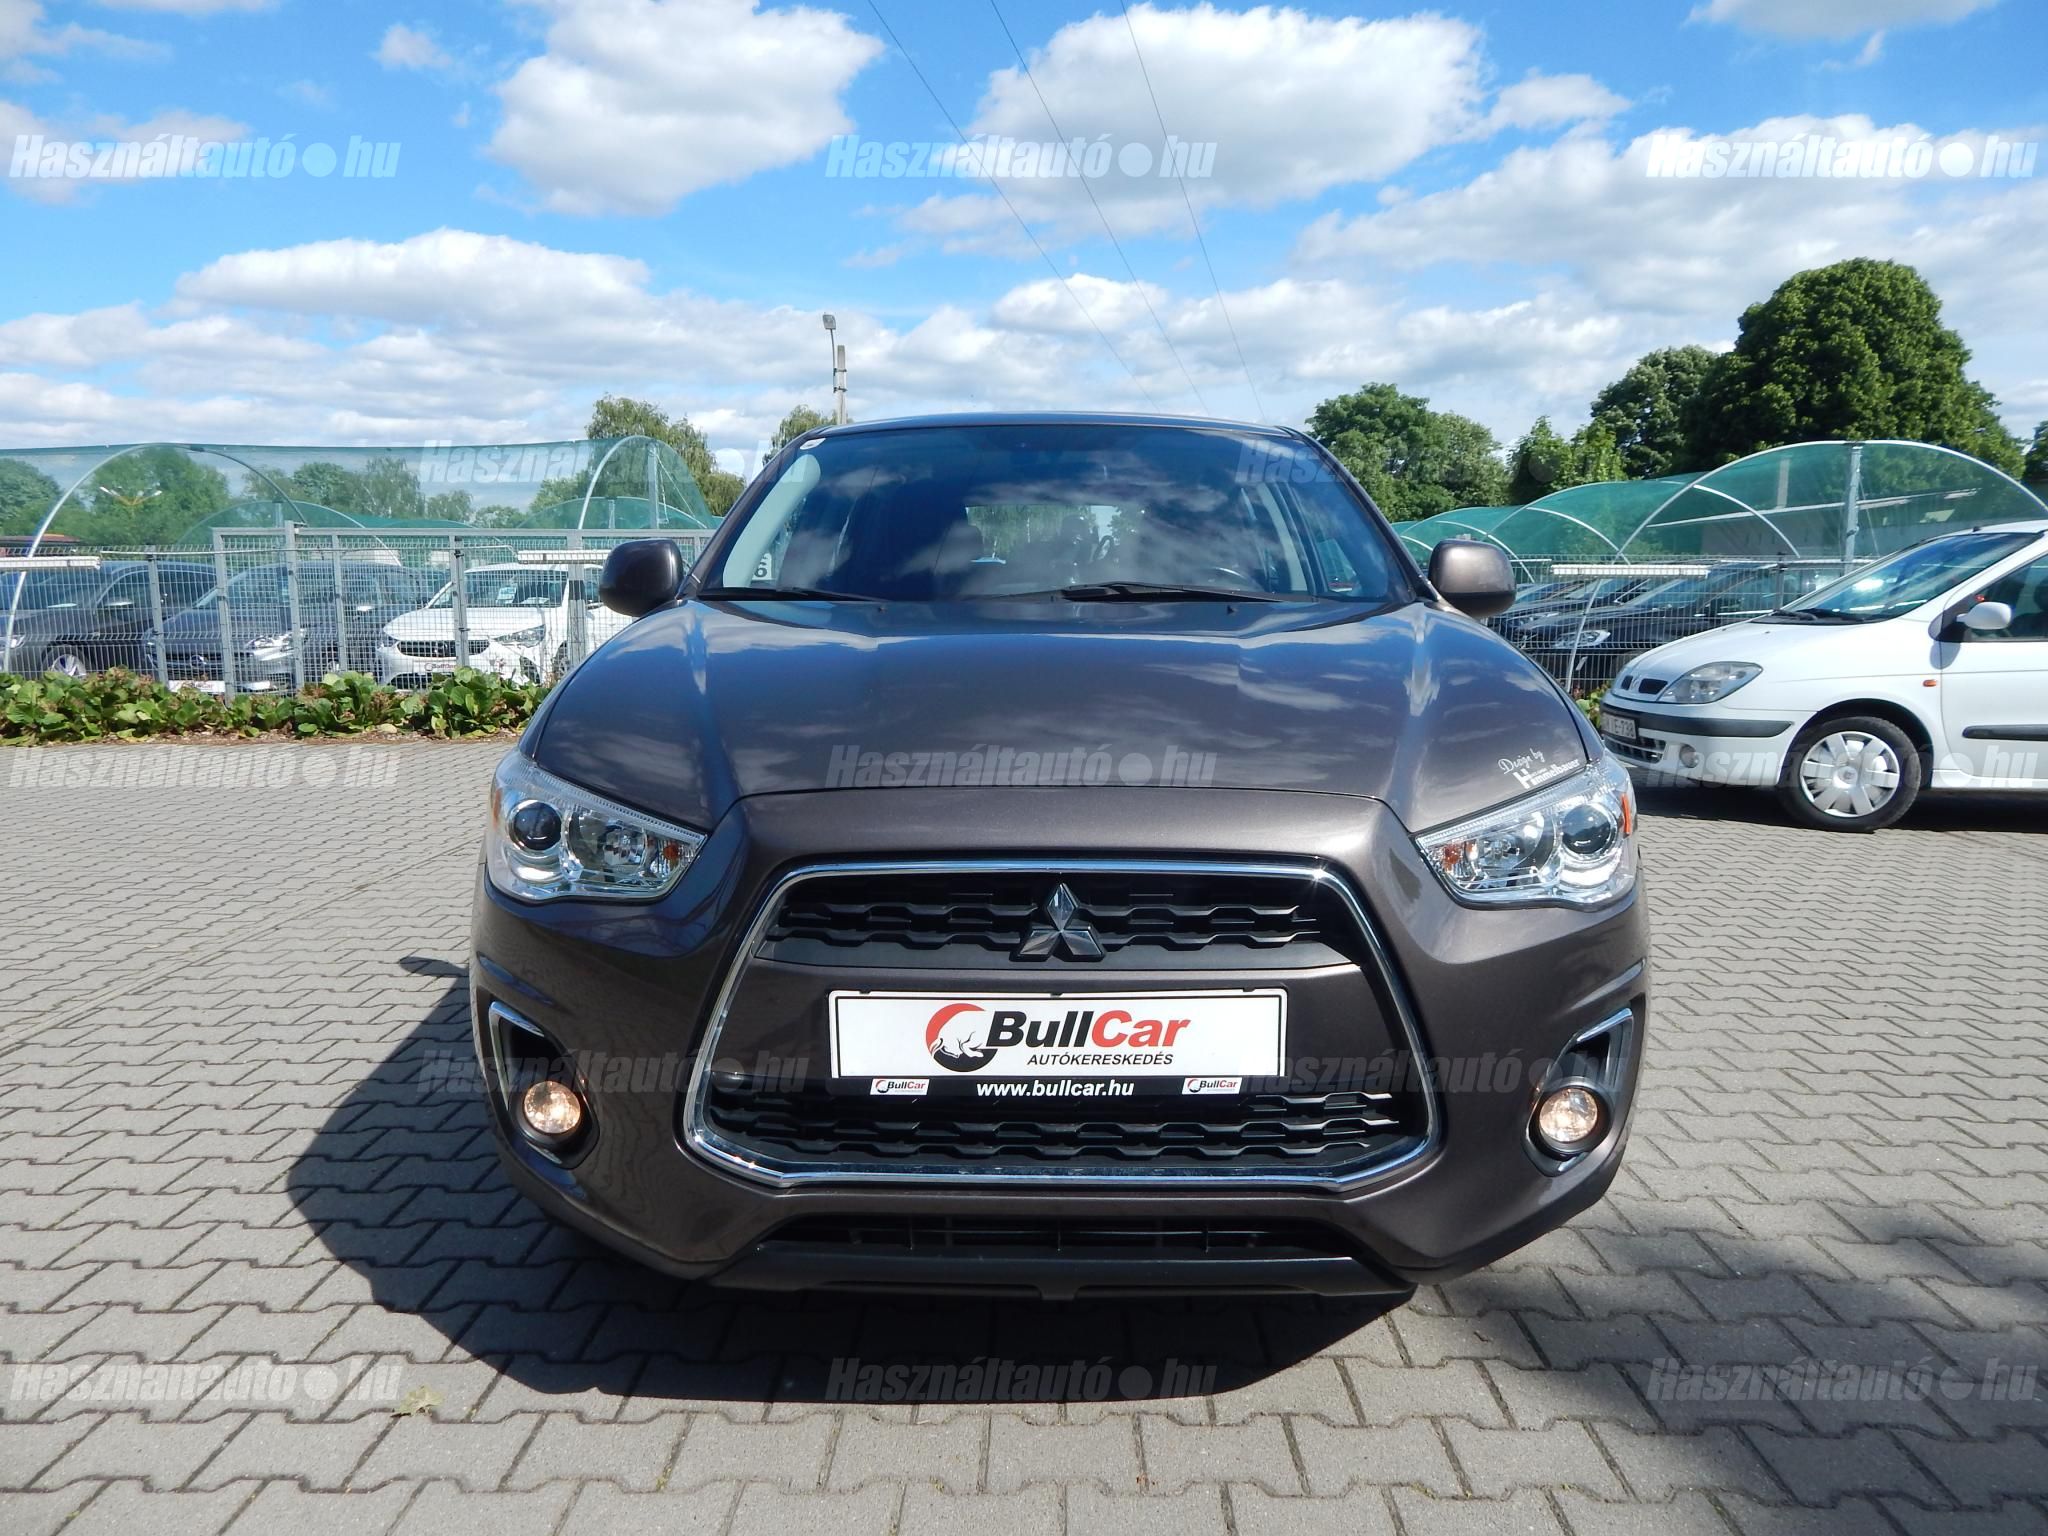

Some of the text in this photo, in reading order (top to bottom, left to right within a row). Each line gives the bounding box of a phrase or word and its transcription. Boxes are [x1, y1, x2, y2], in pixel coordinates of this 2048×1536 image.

[986, 1010, 1192, 1048] BullCar
[1027, 1051, 1174, 1066] AUTÓKERESKEDÉS
[887, 1081, 926, 1089] BullCar
[976, 1079, 1135, 1097] www.bullcar.hu
[1200, 1080, 1238, 1088] BullCar
